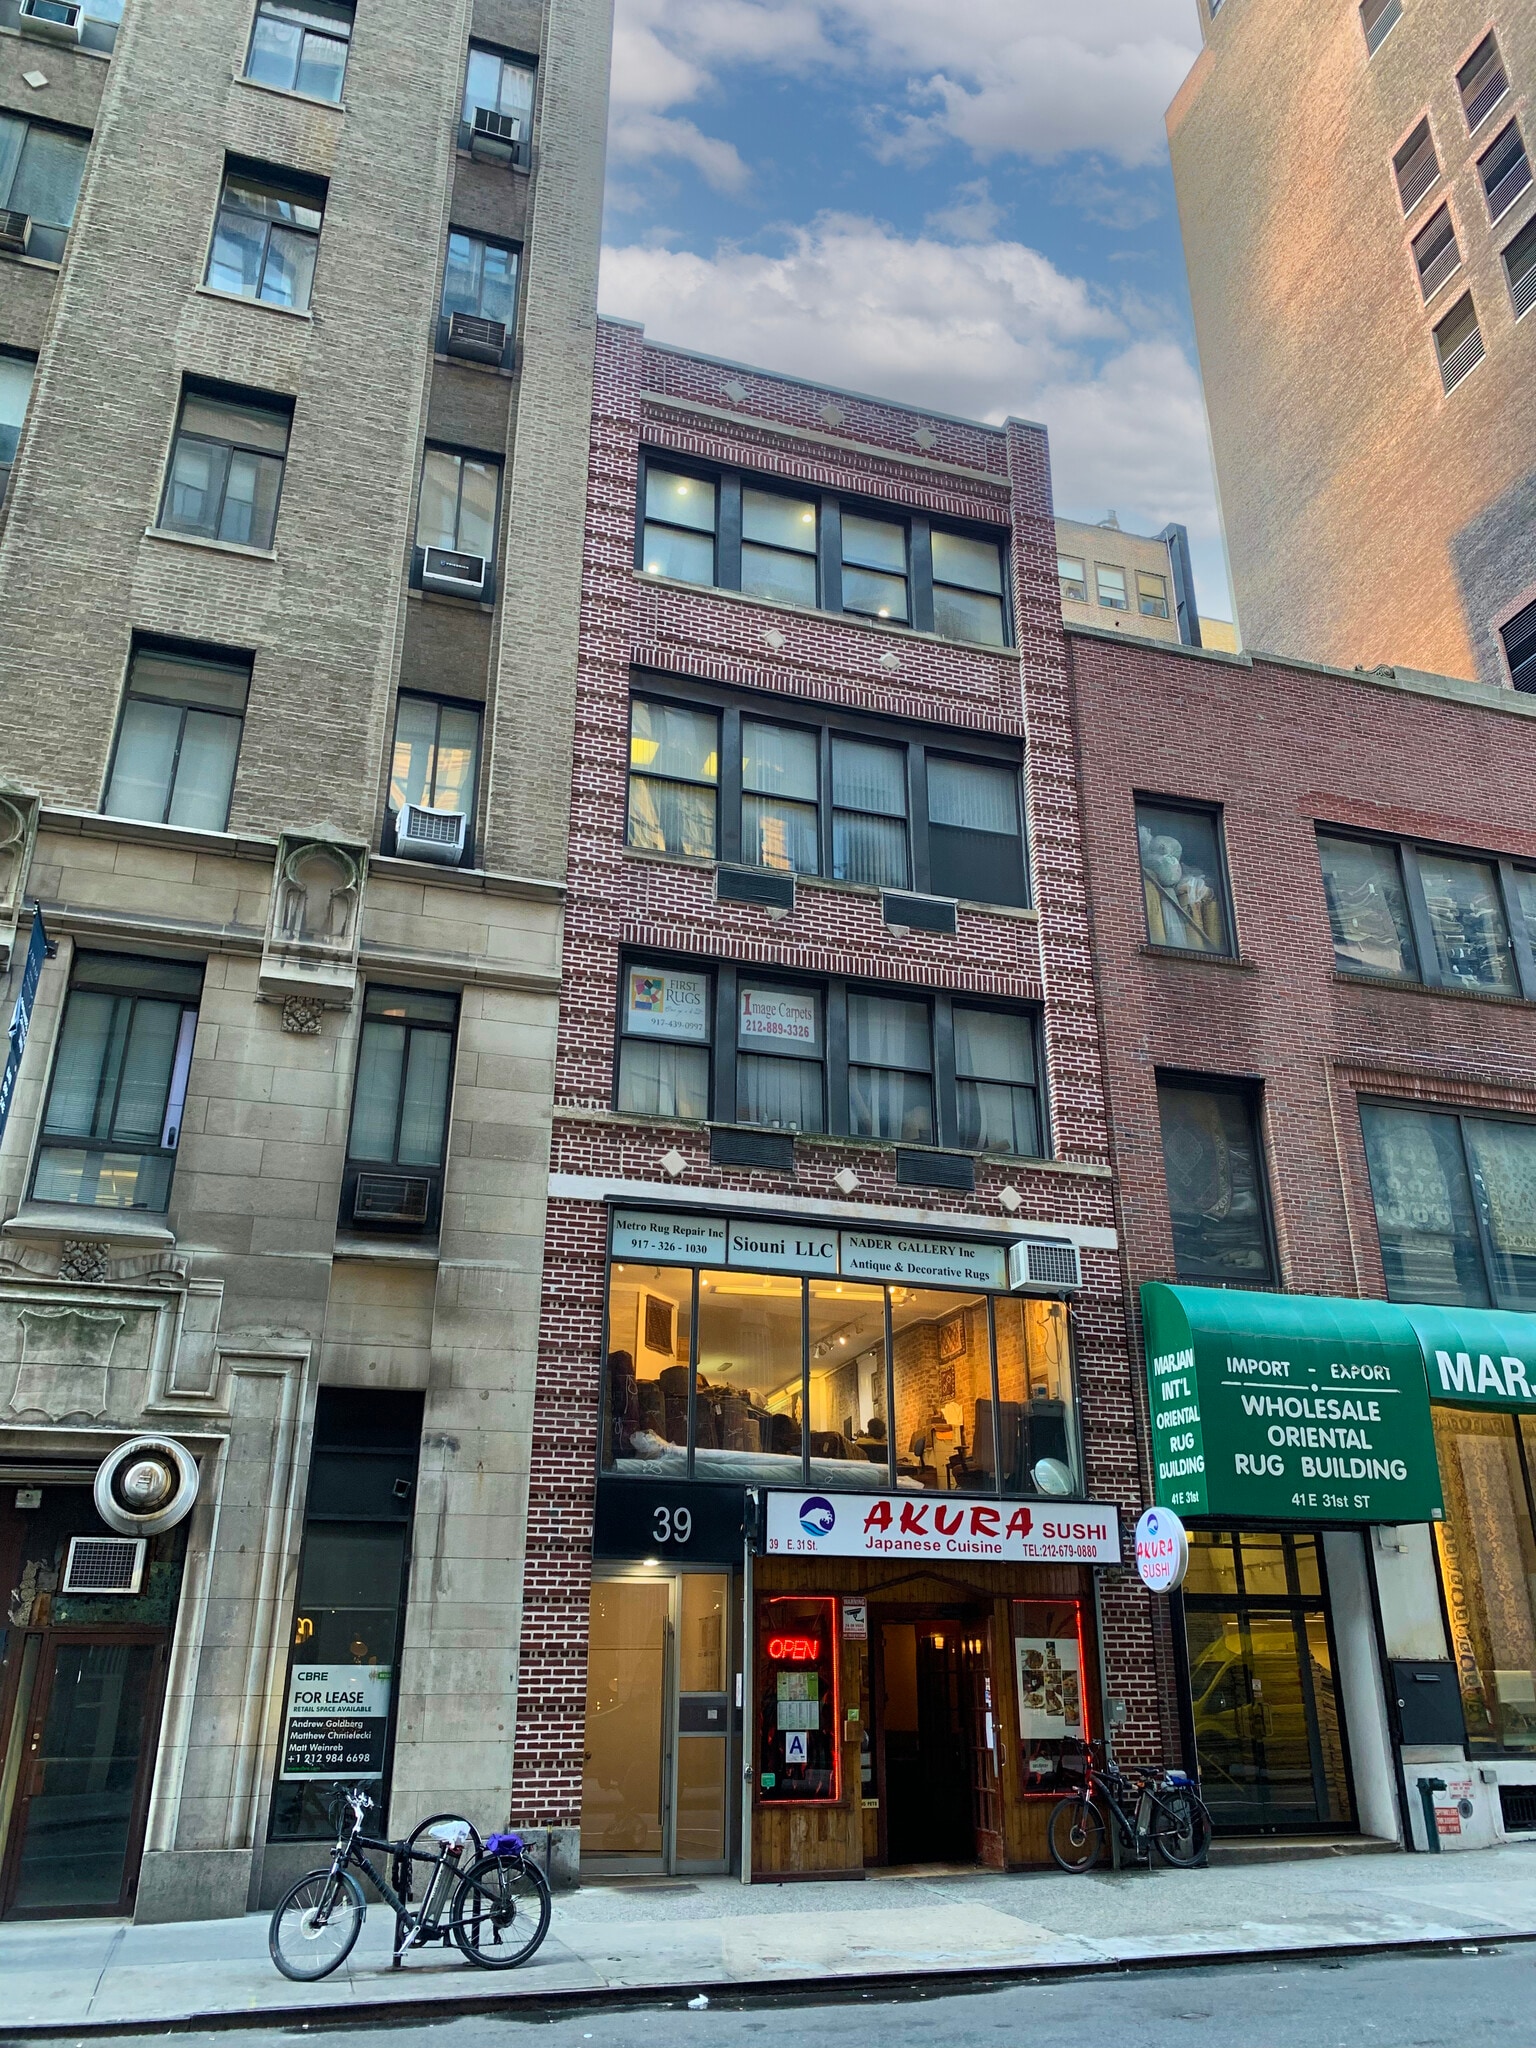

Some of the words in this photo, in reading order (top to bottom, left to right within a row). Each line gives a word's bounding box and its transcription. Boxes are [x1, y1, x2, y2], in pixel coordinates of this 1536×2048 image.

[670, 979, 698, 991] FIRST
[666, 988, 701, 1006] RUGS
[743, 993, 776, 1019] Image
[778, 1002, 812, 1022] Carpets
[746, 1019, 810, 1037] 212-889-3326
[616, 1219, 647, 1232] Metro
[650, 1222, 670, 1236] Rug
[672, 1225, 706, 1239] Repair
[708, 1228, 724, 1238] Inc
[631, 1238, 649, 1249] 917
[658, 1241, 676, 1252] 326
[685, 1243, 708, 1254] 1030
[733, 1235, 785, 1255] Siouni
[795, 1241, 833, 1258] LLC
[849, 1237, 892, 1250] NADER
[897, 1241, 956, 1256] GALLERY
[959, 1247, 976, 1258] Inc
[849, 1258, 892, 1273] Antique
[894, 1262, 904, 1272] &
[907, 1263, 962, 1278] Decorative
[964, 1268, 990, 1283] Rugs
[1153, 1348, 1194, 1376] MARJAN
[1226, 1356, 1290, 1377] IMPORT
[1330, 1363, 1391, 1381] EXPORT
[1434, 1350, 1536, 1398] MAR
[1161, 1377, 1191, 1401] INT'L
[1156, 1405, 1200, 1430] ORIENTAL
[1241, 1394, 1381, 1422] WHOLESALE
[1169, 1432, 1195, 1453] RUG
[1267, 1425, 1373, 1450] ORIENTAL
[1234, 1453, 1285, 1476] RUG
[1301, 1456, 1408, 1481] BUILDING
[1185, 1490, 1200, 1504] 31st
[1322, 1494, 1349, 1508] 31st
[1353, 1495, 1371, 1508] ST
[652, 1506, 692, 1543] 39
[863, 1500, 1034, 1540] AKURA
[1042, 1522, 1107, 1540] SUSHI
[769, 1538, 779, 1550] 39
[787, 1539, 795, 1550] E.
[796, 1539, 805, 1551] 31
[806, 1540, 818, 1551] St.
[865, 1536, 941, 1552] Japanese
[946, 1539, 1002, 1553] Cuisine
[1136, 1538, 1173, 1559] AKURA
[1142, 1562, 1170, 1579] SUSHI
[769, 1639, 819, 1660] OPEN
[297, 1672, 329, 1681] CBRE
[294, 1691, 322, 1704] FOR
[325, 1691, 364, 1704] LEASE
[291, 1720, 324, 1728] Andrew
[325, 1720, 364, 1729] Goldberg
[290, 1731, 325, 1740] Matthew
[327, 1731, 372, 1739] Chmielecki
[789, 1735, 803, 1754] A
[288, 1744, 307, 1752] Matt
[309, 1743, 343, 1751] Weinreb
[288, 1754, 300, 1763] +1
[304, 1754, 323, 1763] 212
[325, 1754, 343, 1763] 984
[346, 1753, 370, 1763] 6698
